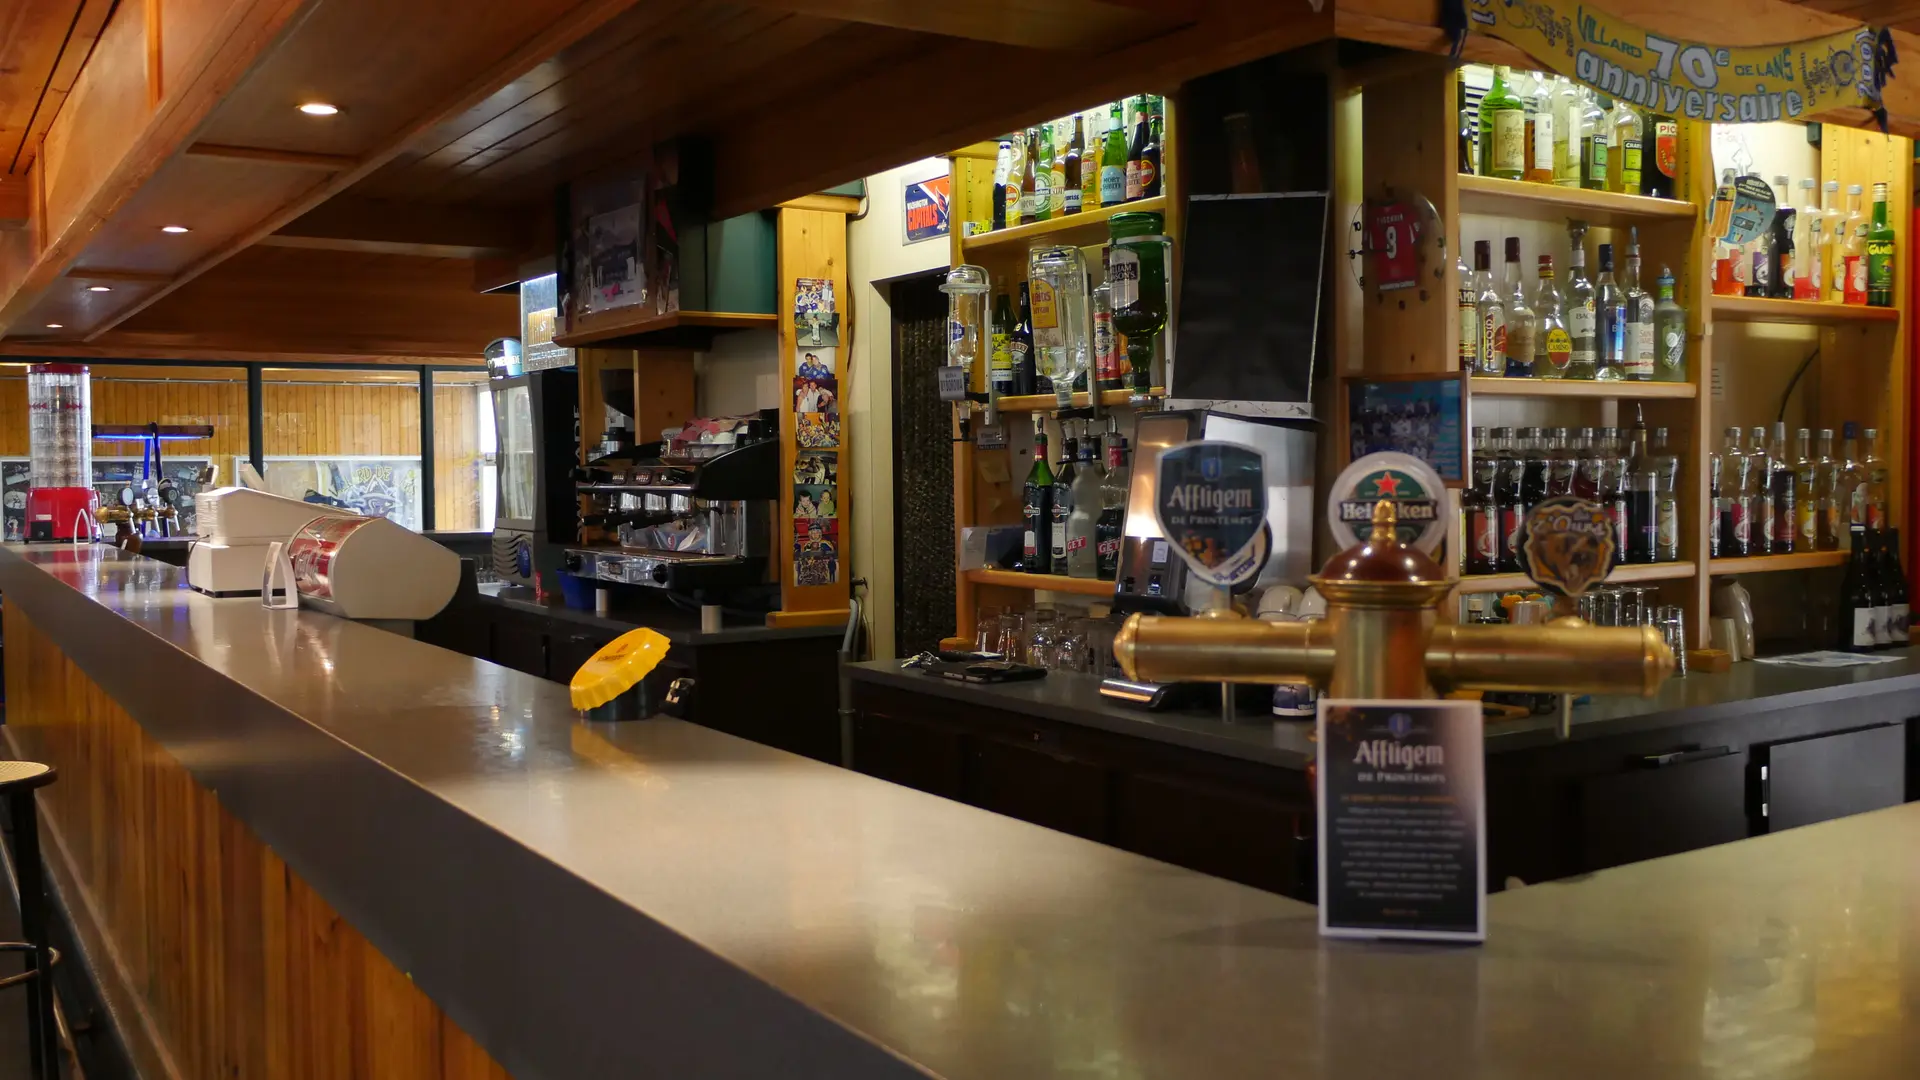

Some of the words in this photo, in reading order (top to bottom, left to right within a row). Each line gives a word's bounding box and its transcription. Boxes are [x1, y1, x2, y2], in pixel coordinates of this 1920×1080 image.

[1578, 5, 1642, 58] VILLARD
[1734, 64, 1755, 77] DE
[1756, 47, 1794, 81] LANS
[1576, 49, 1803, 122] anniversaire
[907, 203, 938, 232] CAPITALS
[1386, 226, 1397, 259] 9
[1166, 484, 1253, 513] Affligem
[1341, 502, 1434, 520] Heiken
[1171, 516, 1186, 525] DE
[1067, 537, 1084, 551] GET
[1353, 739, 1445, 772] Affligem
